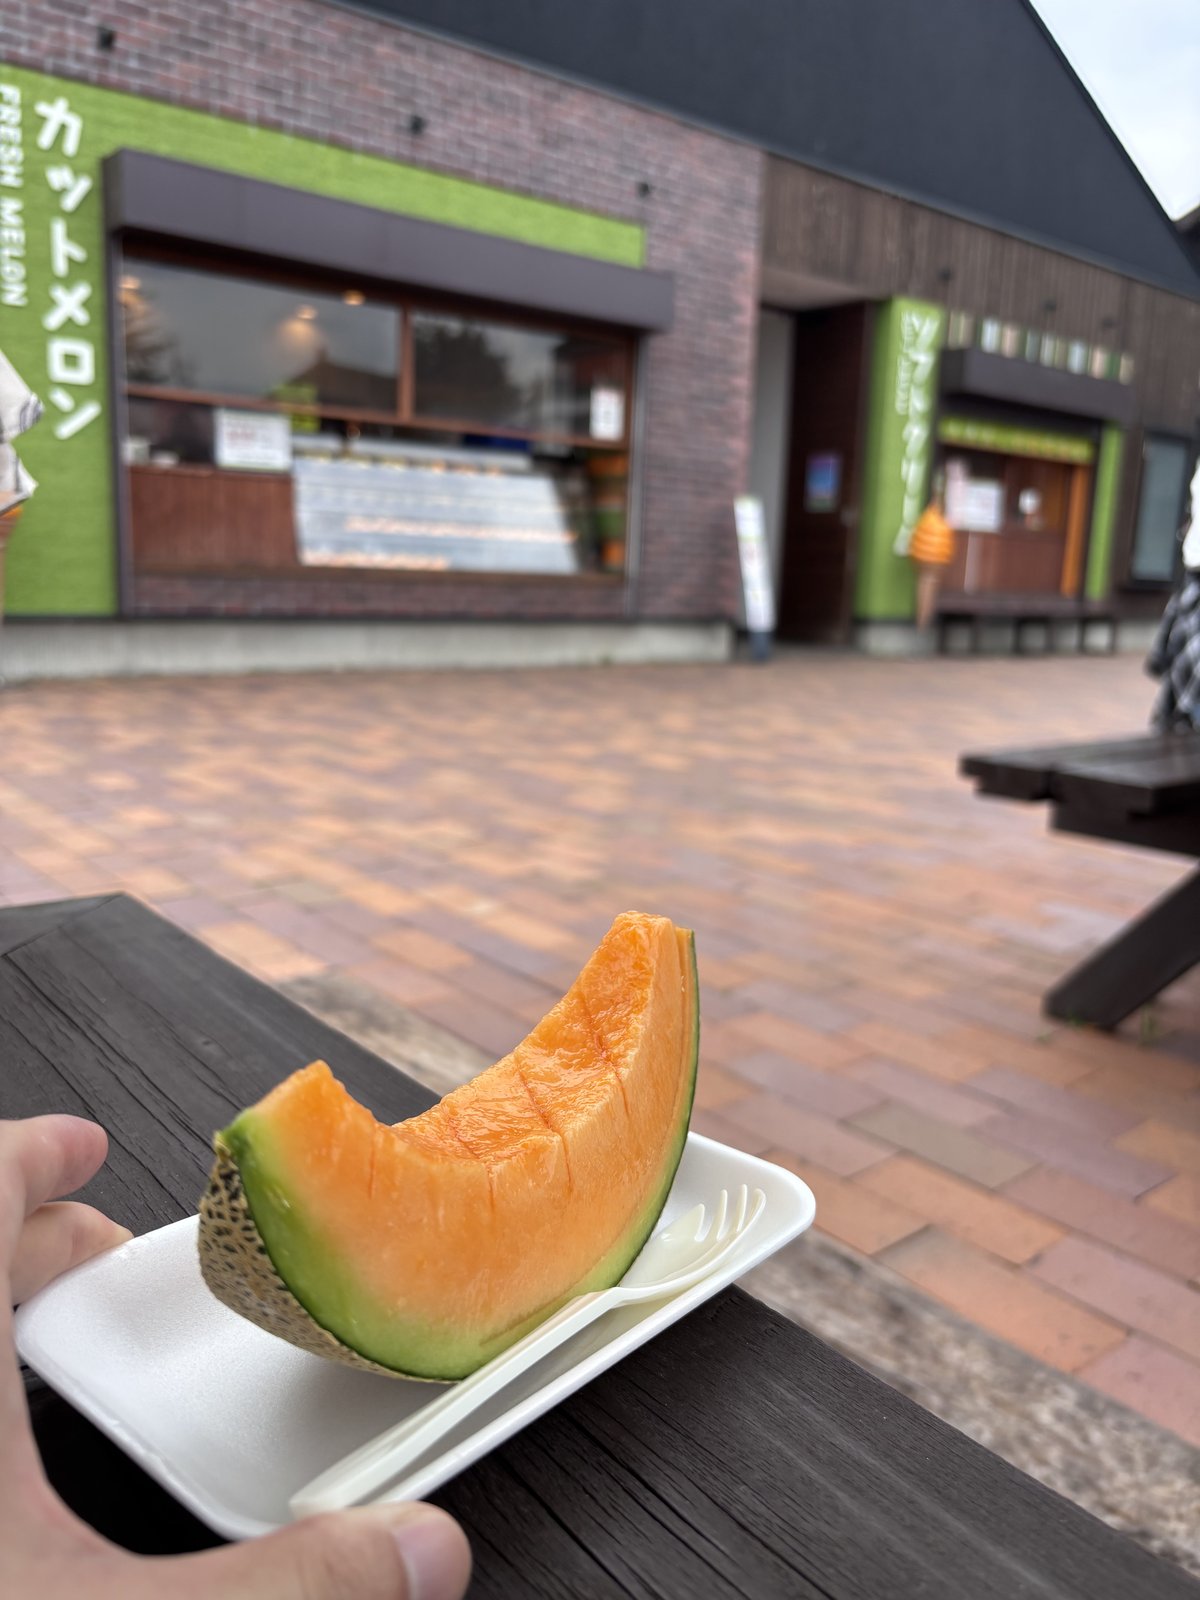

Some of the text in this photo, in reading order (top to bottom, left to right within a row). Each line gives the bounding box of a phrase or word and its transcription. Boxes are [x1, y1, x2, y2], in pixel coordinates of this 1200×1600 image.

[0, 84, 27, 306] FRESH MELON
[34, 96, 101, 440] カットメロン
